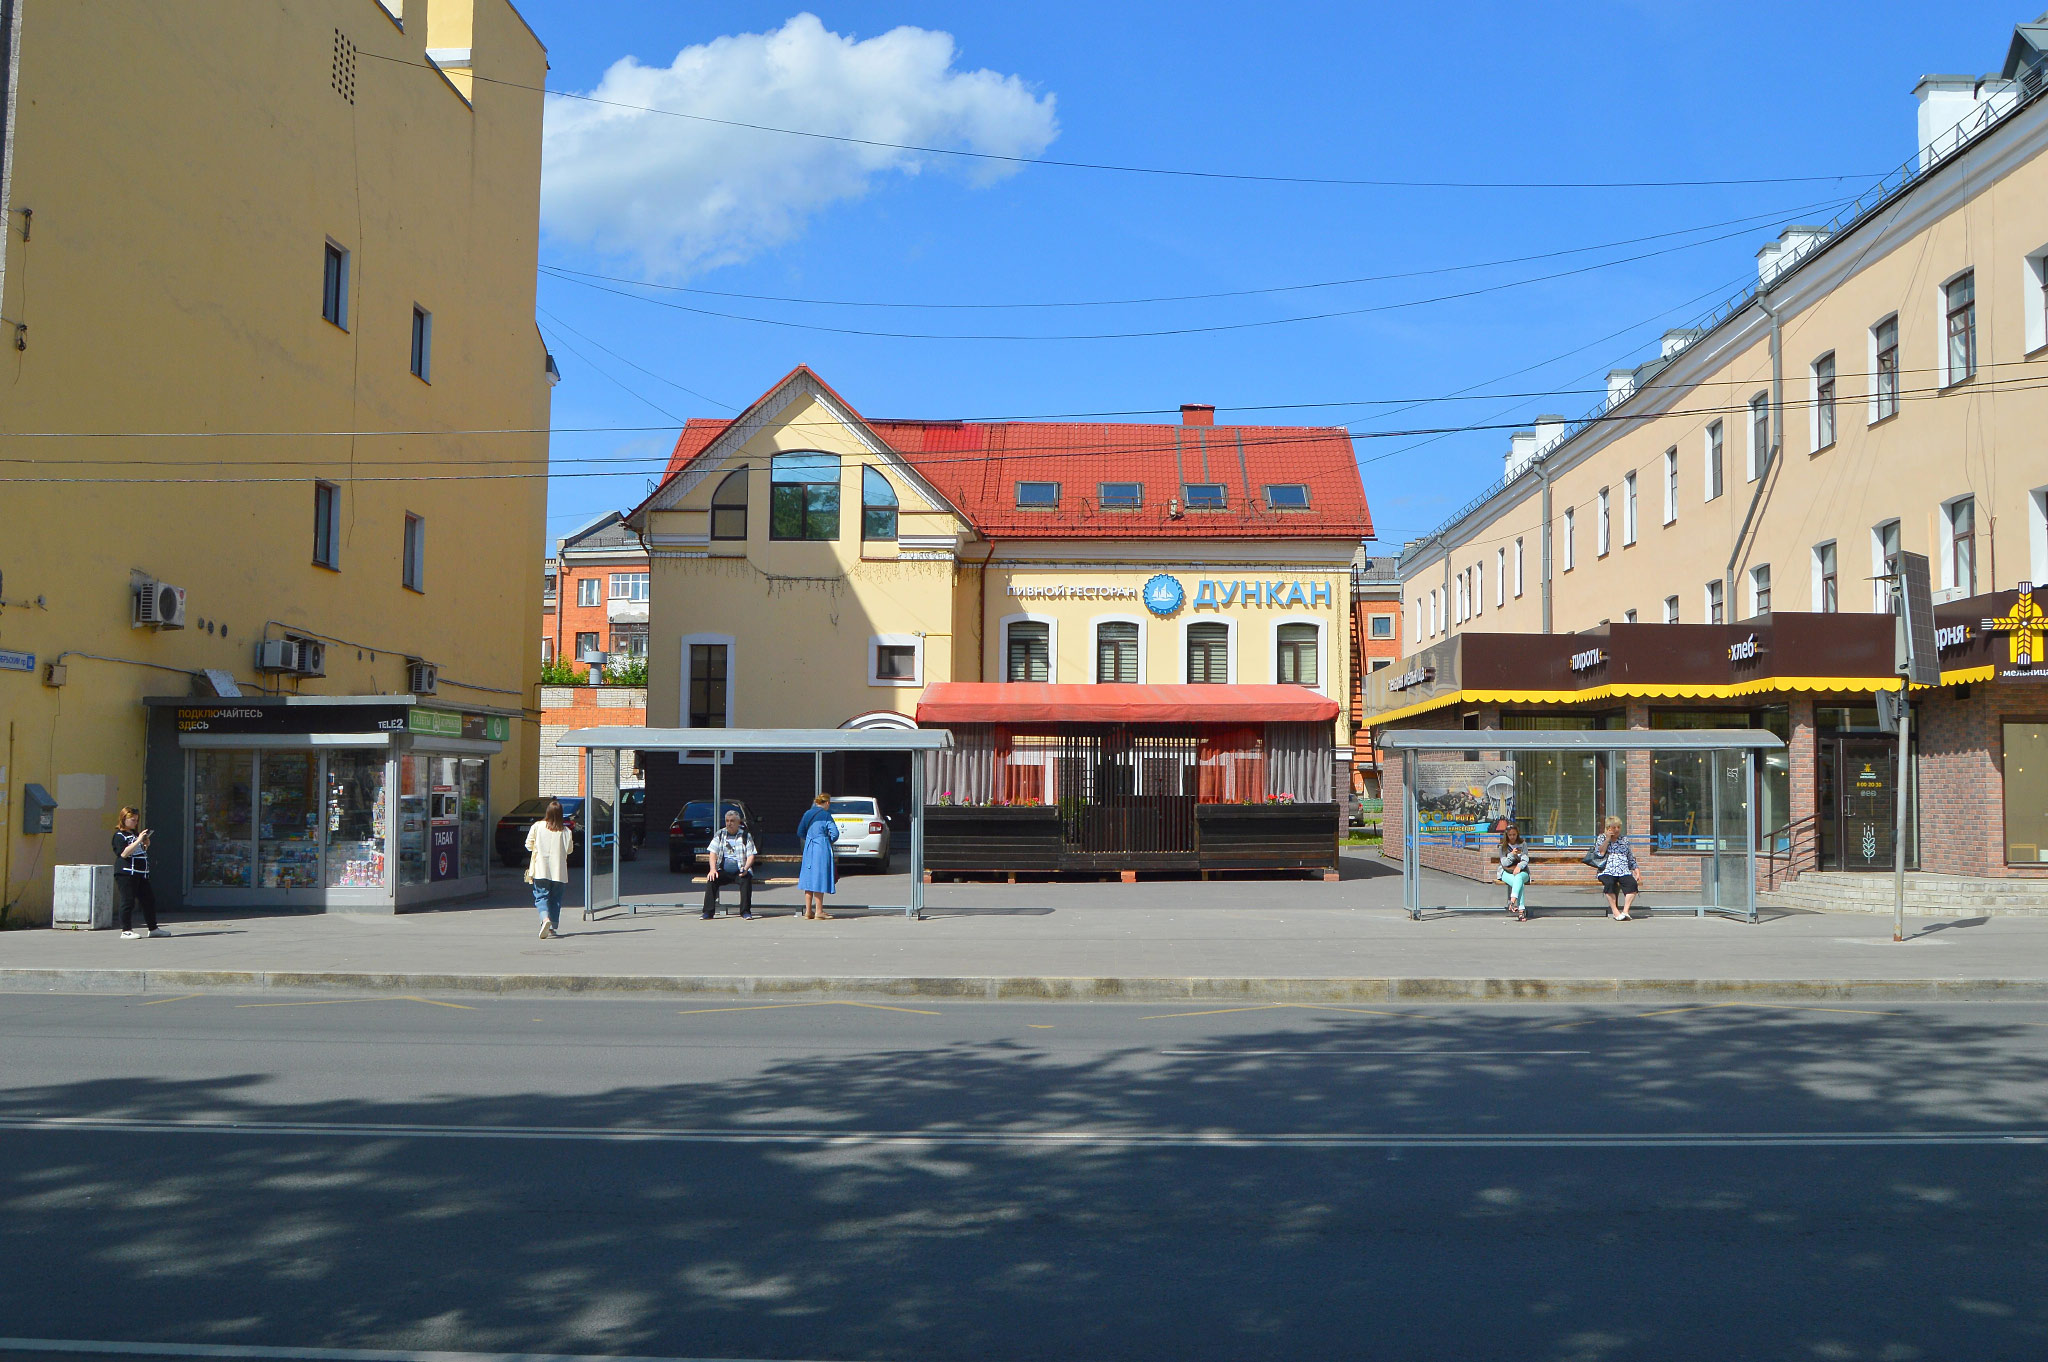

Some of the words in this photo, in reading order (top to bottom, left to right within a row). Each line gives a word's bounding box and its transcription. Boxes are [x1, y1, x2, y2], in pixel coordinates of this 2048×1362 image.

[1006, 585, 1065, 596] ПИВНОЙ
[1069, 586, 1136, 597] РЕСТОРАН
[1193, 580, 1331, 608] ДУНКАН
[1731, 632, 1754, 662] хлеб
[1571, 647, 1600, 672] пироги
[178, 707, 263, 720] ПОДКЛЮЧАЙТЕСЬ
[178, 720, 209, 731] ЗДЕСЬ
[378, 718, 404, 729] TELE2
[435, 831, 454, 846] ТАБАК
